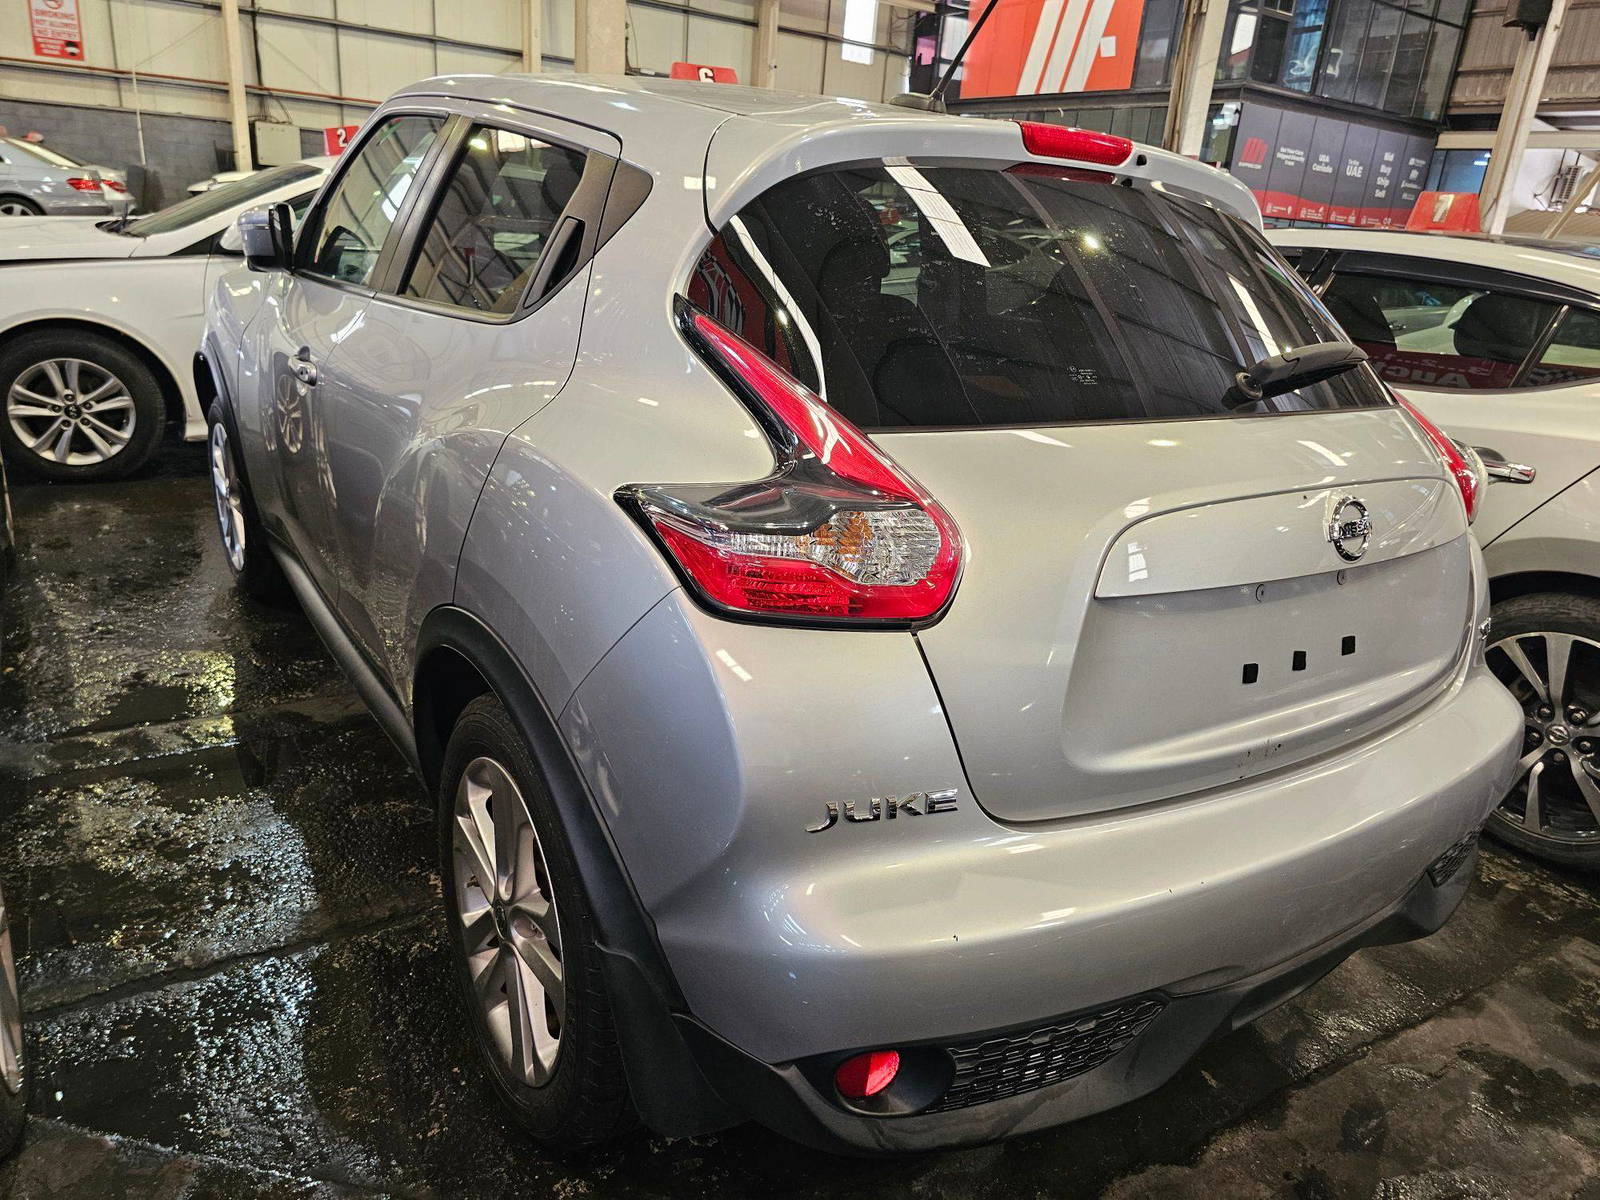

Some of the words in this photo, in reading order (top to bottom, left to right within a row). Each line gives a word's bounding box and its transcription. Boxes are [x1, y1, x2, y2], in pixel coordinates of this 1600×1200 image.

[337, 128, 348, 148] 2
[1346, 165, 1363, 178] UAE
[1380, 164, 1392, 176] Buy
[1432, 193, 1455, 222] 7
[805, 788, 958, 833] JUKE
